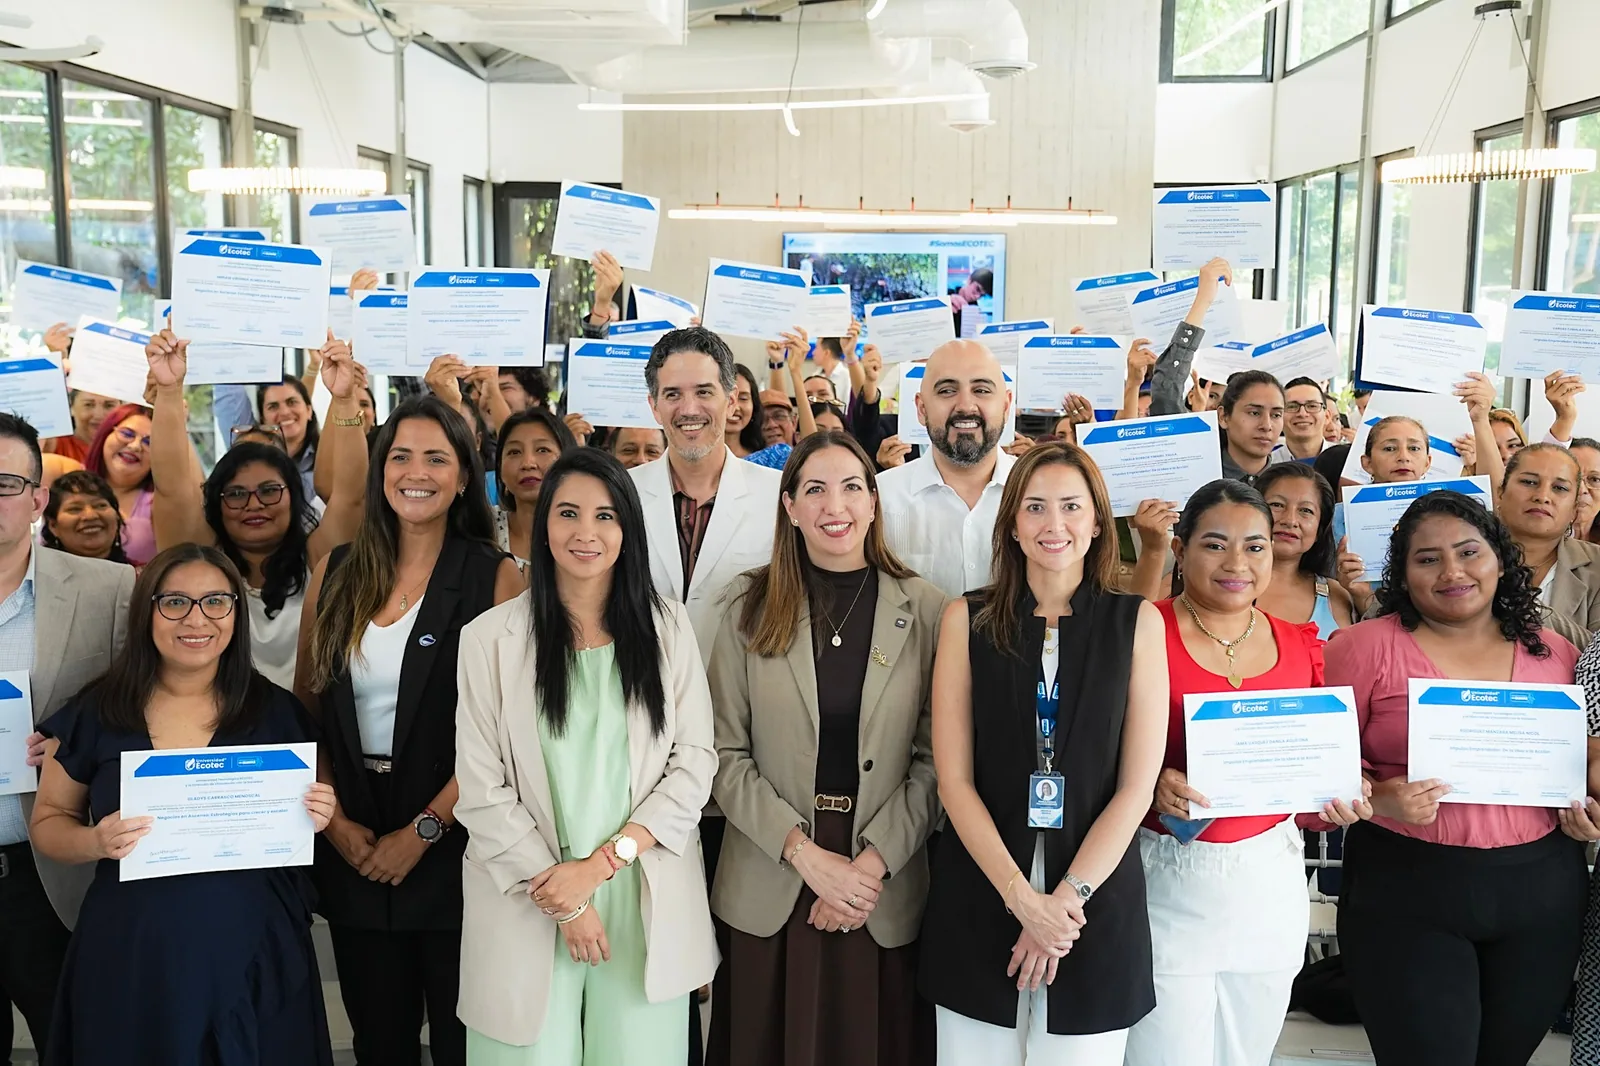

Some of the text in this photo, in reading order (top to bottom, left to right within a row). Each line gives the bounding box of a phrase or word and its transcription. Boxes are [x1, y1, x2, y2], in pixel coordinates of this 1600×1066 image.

[928, 239, 994, 248] #SomosECOTEC
[1471, 694, 1498, 702] Ecotec
[1242, 705, 1268, 713] Ecotec
[196, 762, 224, 770] Ecotec
